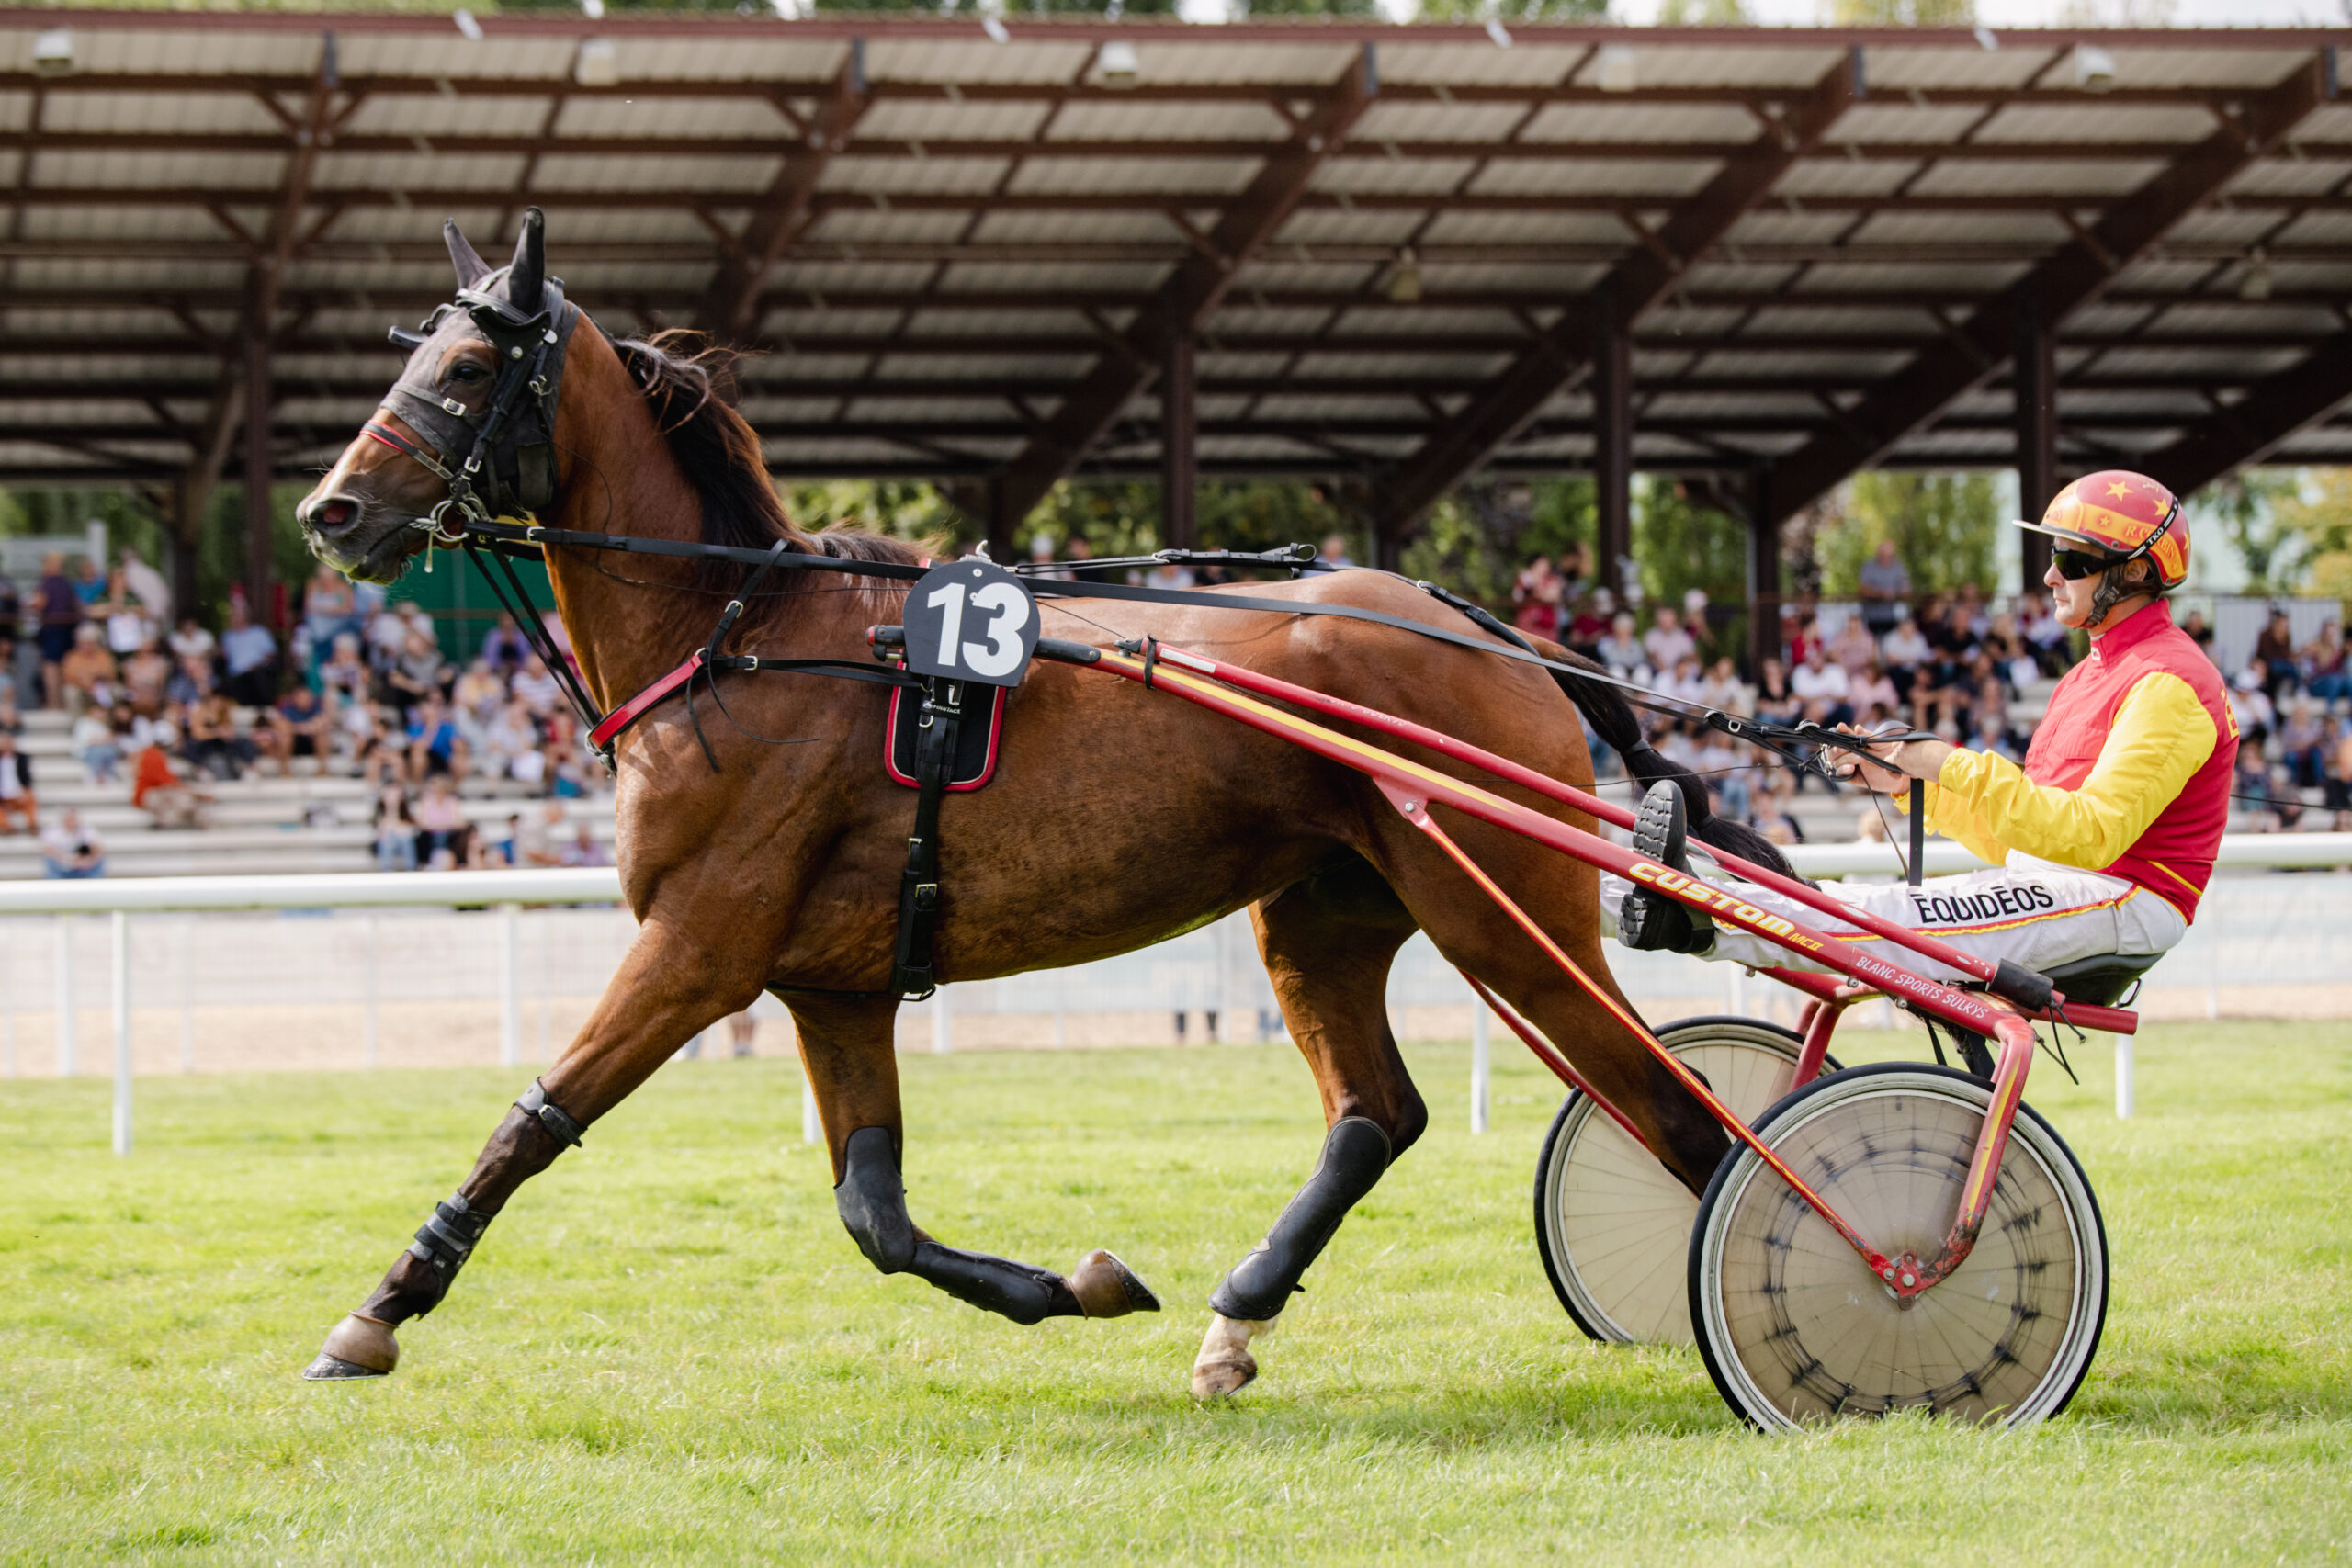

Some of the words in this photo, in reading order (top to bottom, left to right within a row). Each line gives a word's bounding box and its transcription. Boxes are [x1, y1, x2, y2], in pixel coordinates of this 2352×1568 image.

[2146, 526, 2164, 546] TKO
[927, 582, 1030, 677] 13
[1629, 862, 1795, 937] CUSTOM
[1856, 956, 1897, 980] BLANC
[1894, 974, 1944, 999] SPORTS
[1942, 994, 1989, 1019] SULKYS
